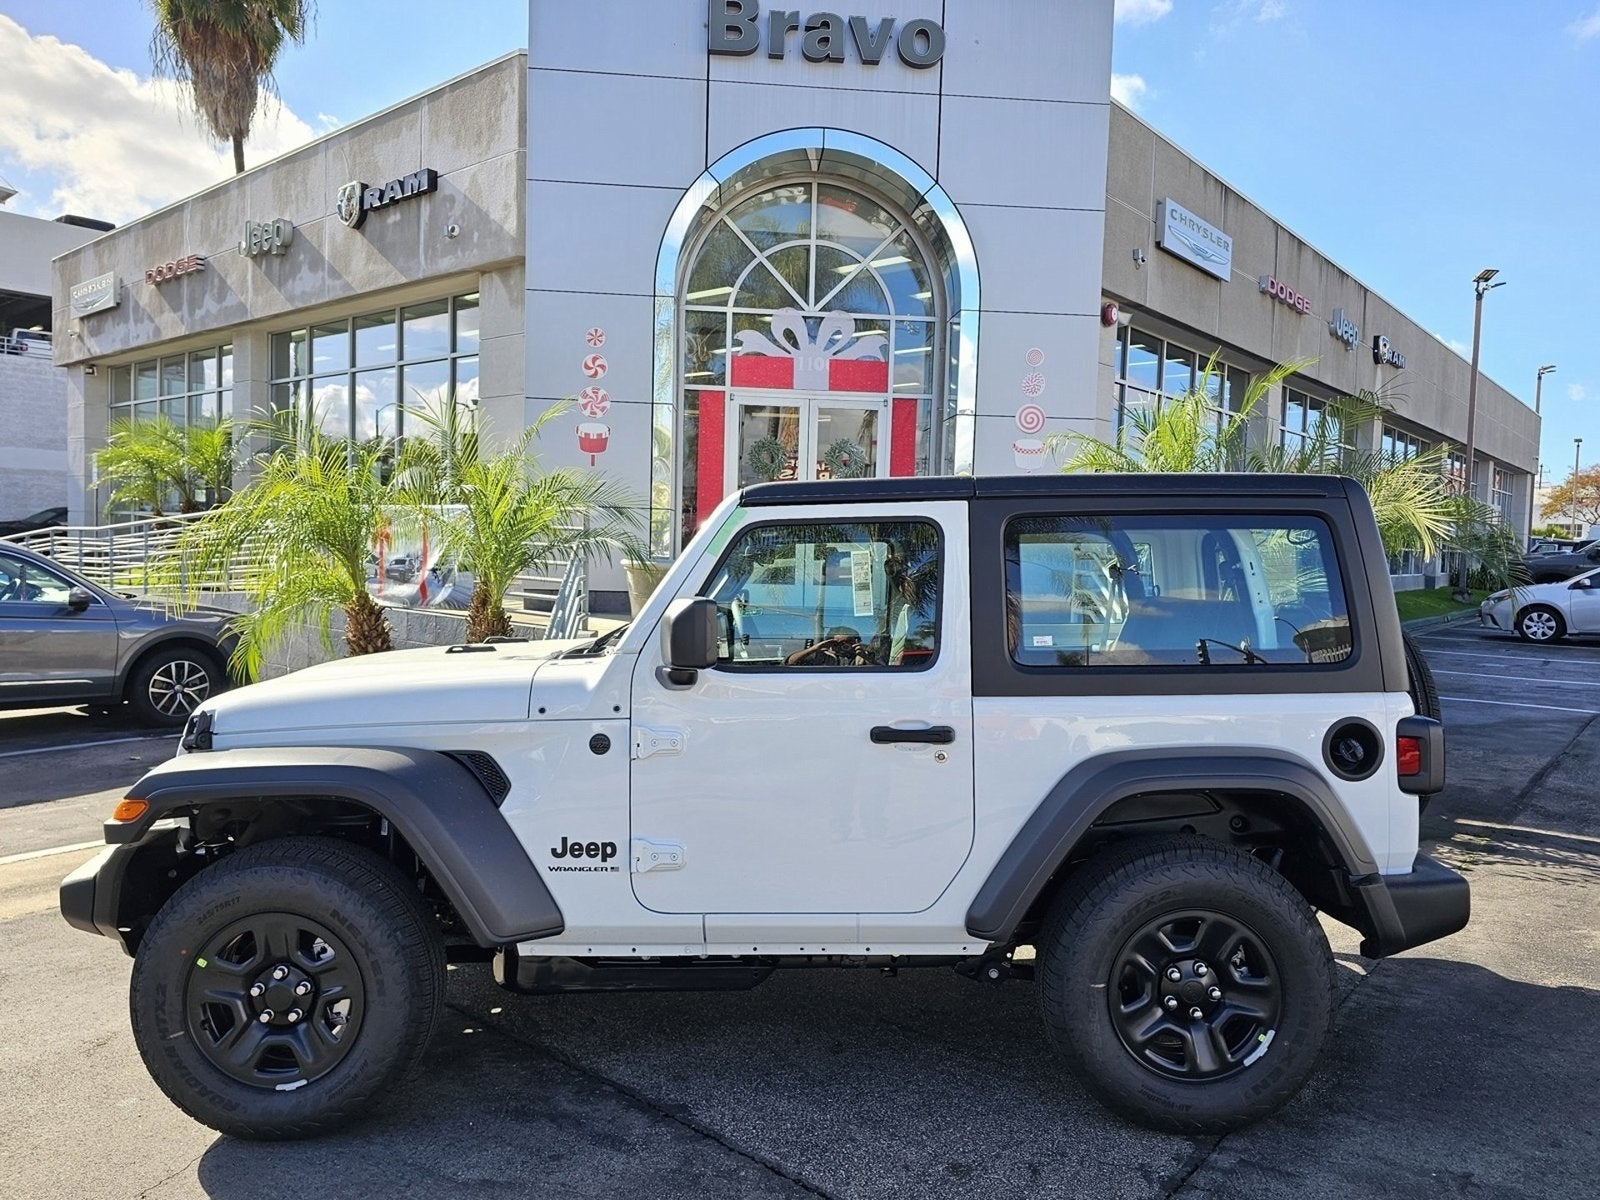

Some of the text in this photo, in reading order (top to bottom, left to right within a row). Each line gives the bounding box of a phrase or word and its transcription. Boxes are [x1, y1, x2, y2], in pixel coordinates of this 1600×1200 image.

[708, 0, 946, 69] Bravo
[365, 169, 436, 210] RAM
[238, 219, 290, 257] Jeep
[1169, 208, 1231, 253] CHRYSLER
[145, 255, 203, 284] DODGE
[1267, 276, 1311, 313] DODGE
[1335, 308, 1360, 350] Jeep
[798, 356, 829, 371] 110
[1387, 349, 1406, 369] RAM
[550, 836, 617, 863] Jeep
[547, 865, 609, 873] WRANGLER
